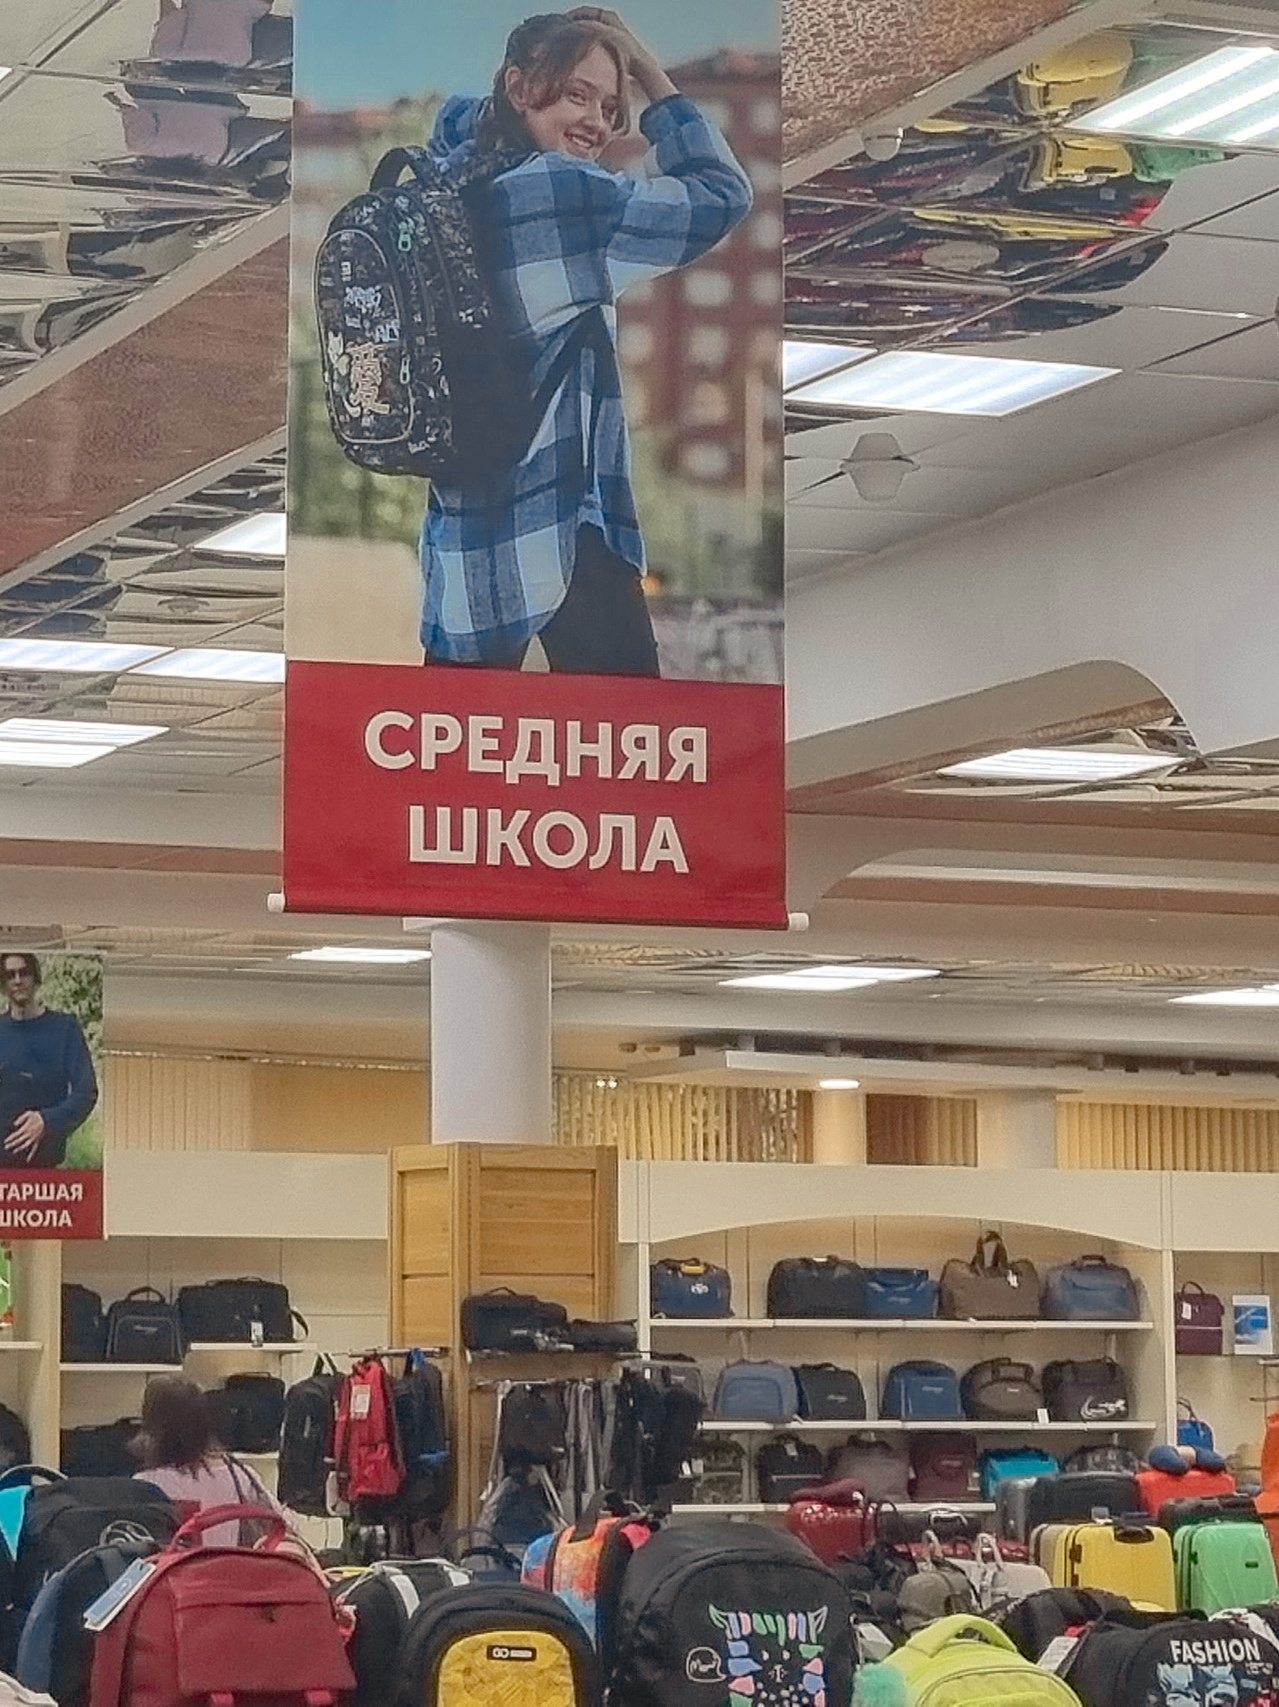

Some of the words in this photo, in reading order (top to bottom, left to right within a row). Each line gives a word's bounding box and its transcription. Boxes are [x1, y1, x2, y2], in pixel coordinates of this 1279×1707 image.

[363, 709, 708, 787] СРЕДНЯЯ
[408, 804, 690, 874] ШКОЛА
[1169, 1638, 1261, 1664] FASHION
